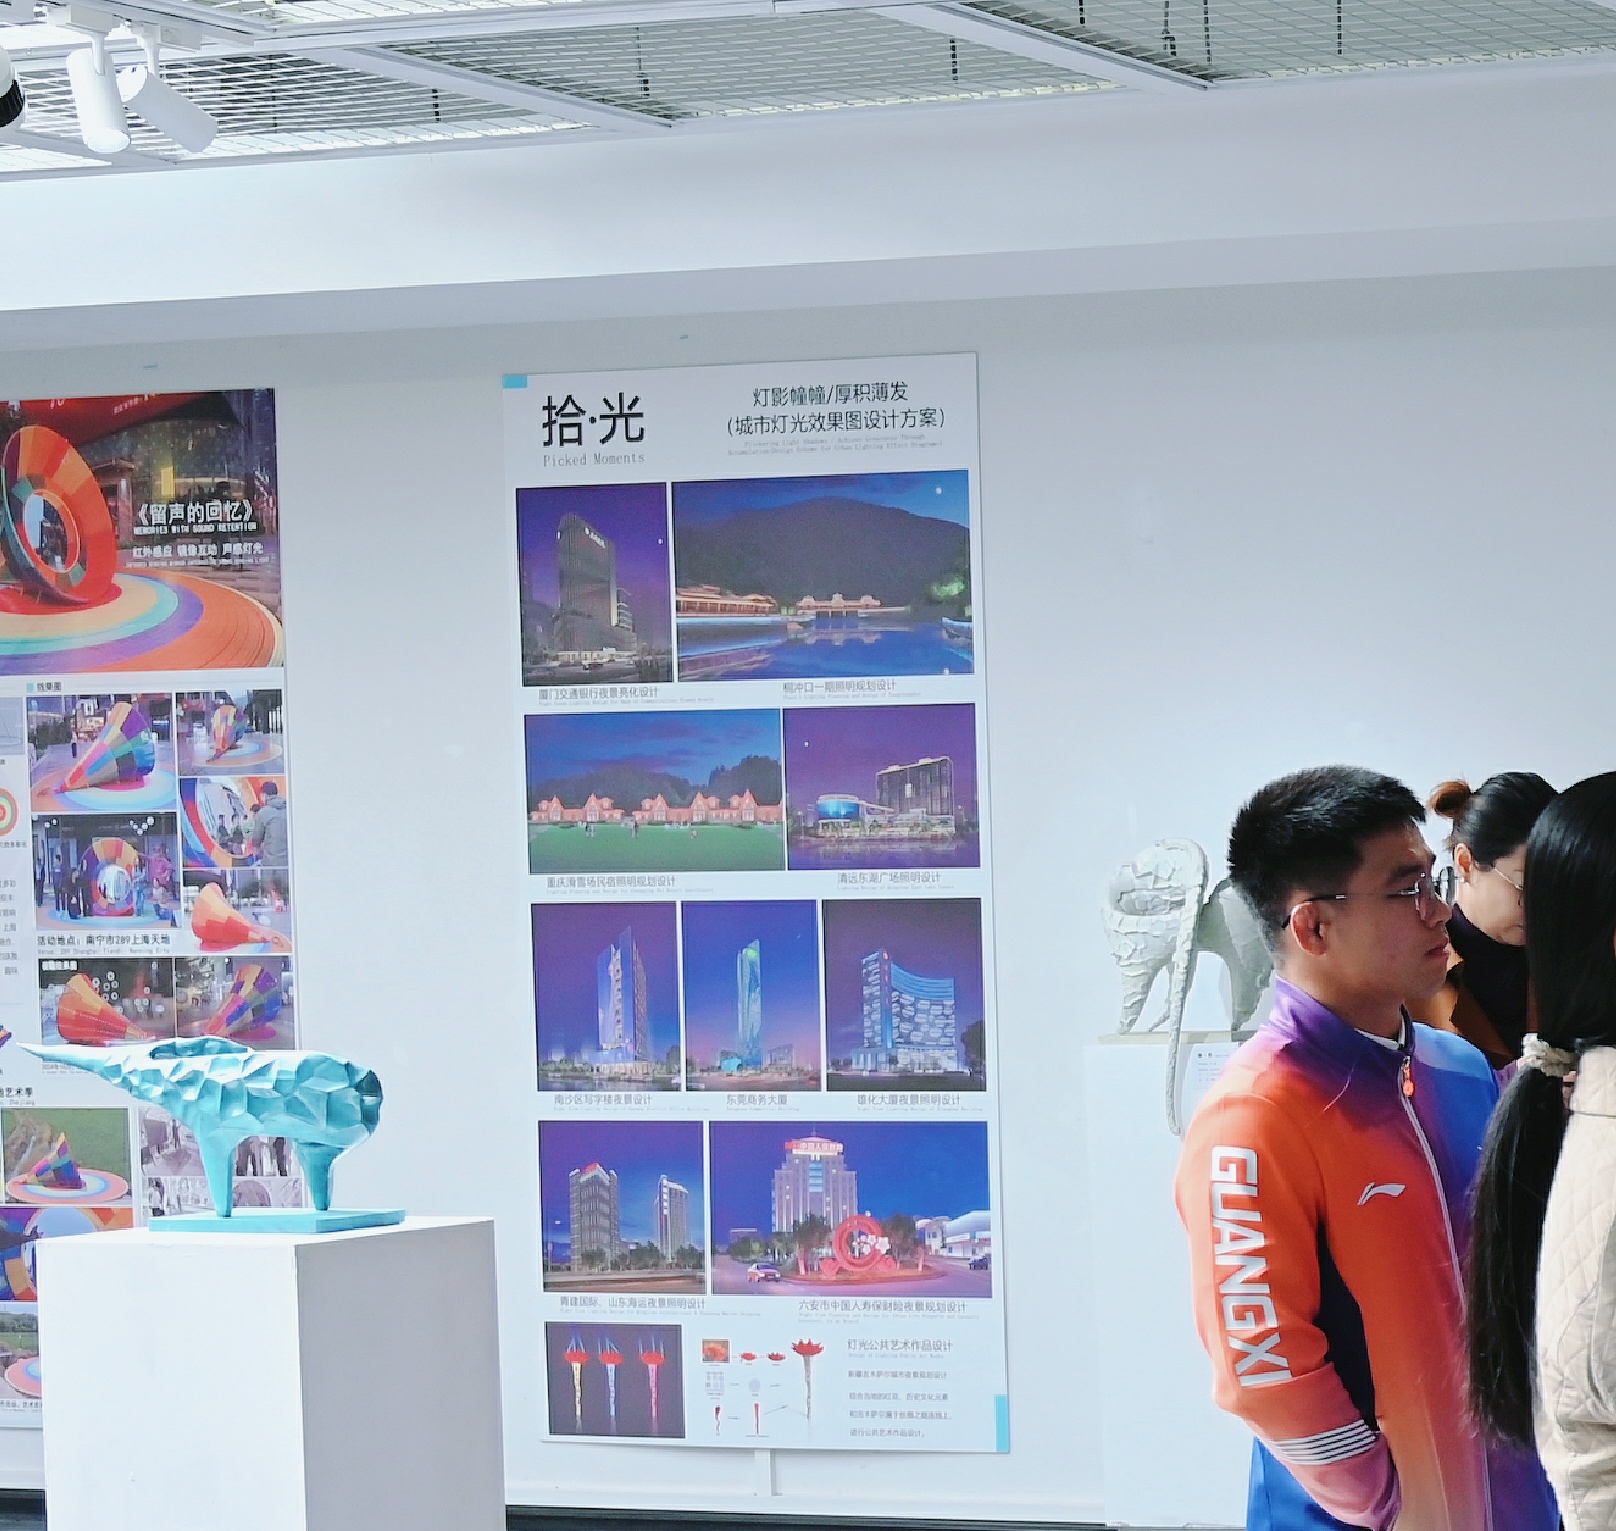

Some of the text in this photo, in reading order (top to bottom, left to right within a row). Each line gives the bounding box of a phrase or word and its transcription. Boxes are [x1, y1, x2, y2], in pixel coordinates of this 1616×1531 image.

[753, 381, 909, 408] 灯影幢幢/厚积薄发
[727, 405, 947, 437] (城市灯光效果图设计方案)
[543, 451, 645, 468] Picked Moments
[138, 499, 253, 526] 《留声的回忆》
[1211, 1145, 1293, 1387] GUANGXI
[847, 1338, 954, 1353] 灯光公共艺术作品设计
